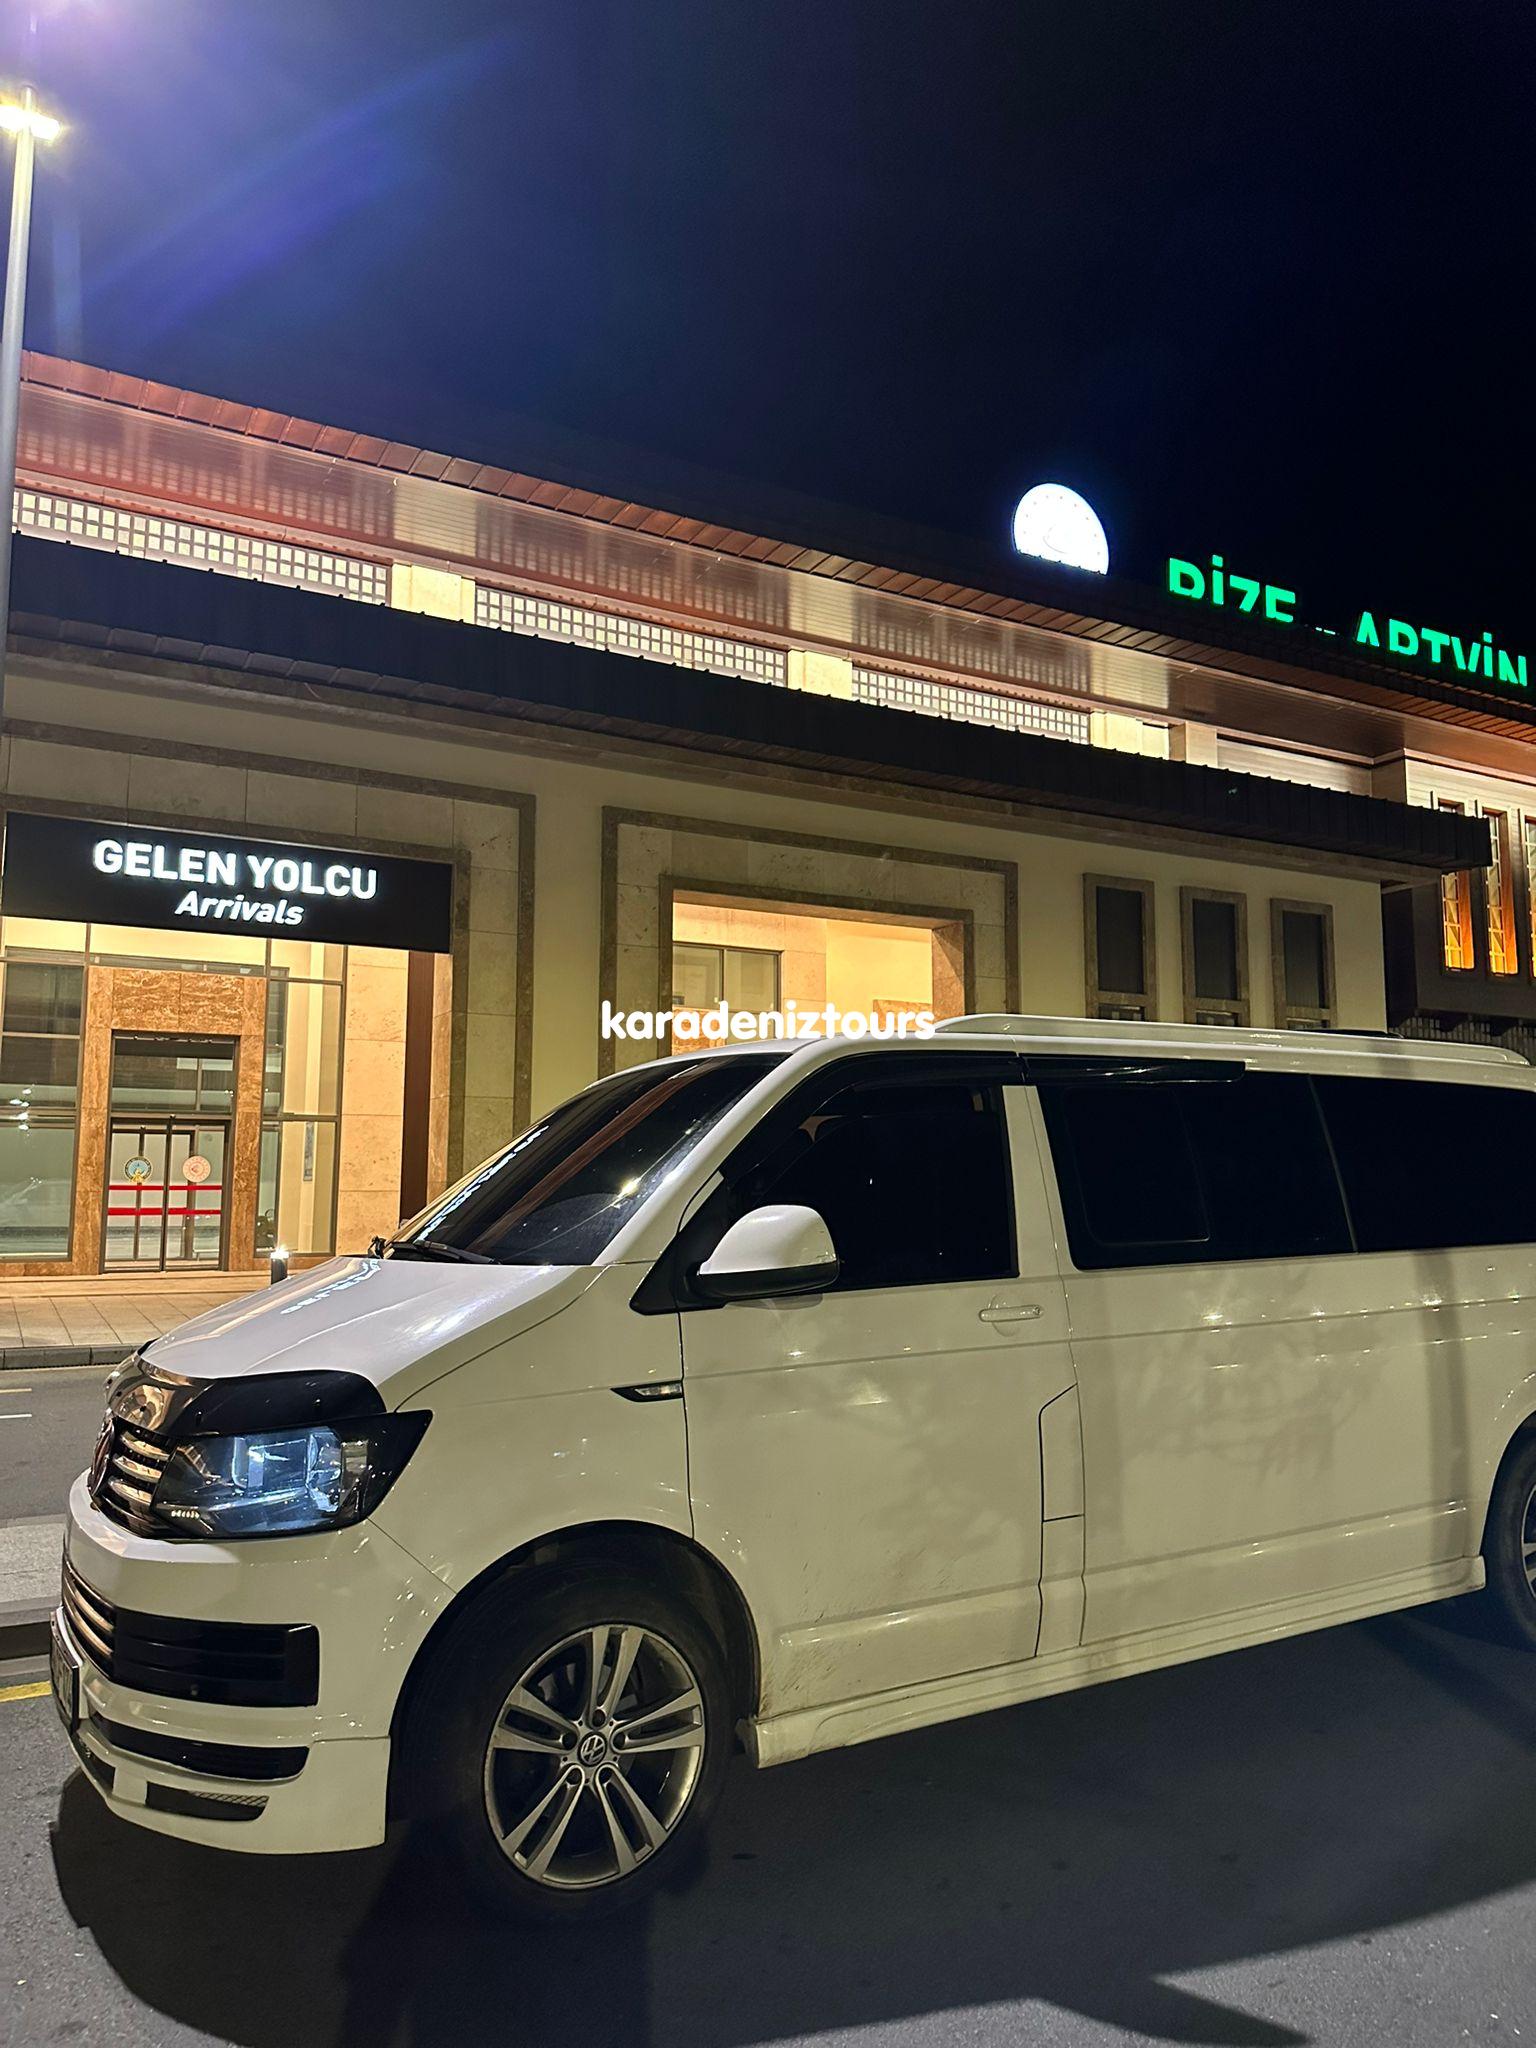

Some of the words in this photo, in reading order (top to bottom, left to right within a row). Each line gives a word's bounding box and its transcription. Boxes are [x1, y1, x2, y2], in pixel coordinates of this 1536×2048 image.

[93, 838, 238, 886] GELEN
[246, 854, 378, 900] YOLCU
[174, 890, 305, 926] Arrivals
